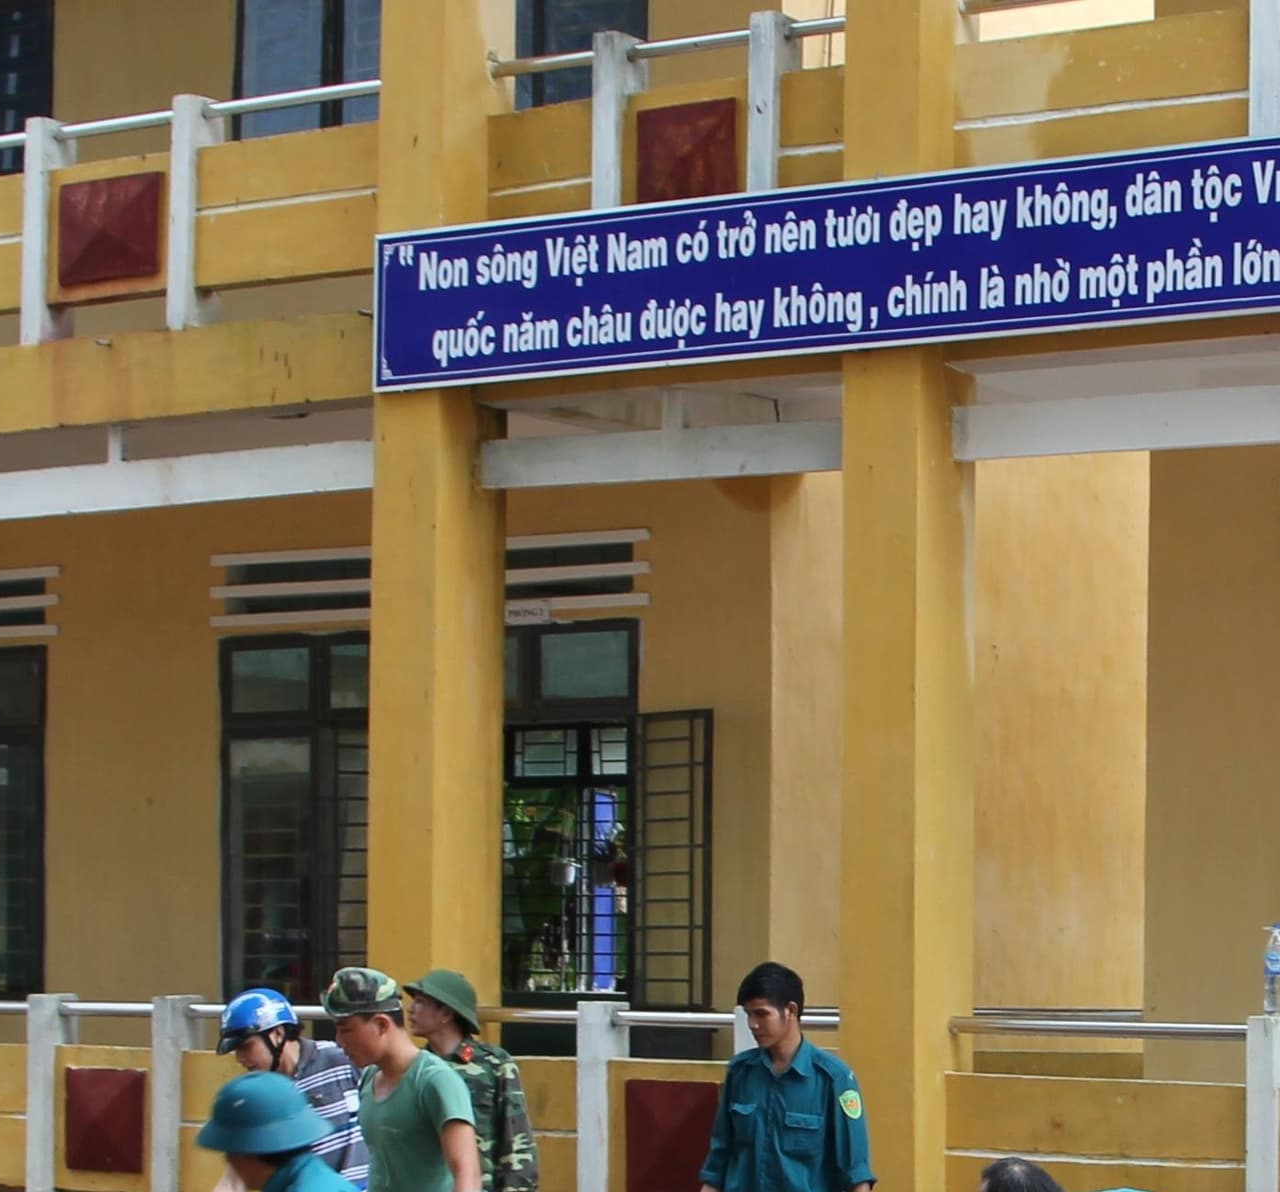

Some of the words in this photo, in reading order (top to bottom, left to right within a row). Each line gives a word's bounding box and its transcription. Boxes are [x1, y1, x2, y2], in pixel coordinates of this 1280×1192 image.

[477, 244, 538, 288] sông
[608, 232, 668, 272] Nam
[677, 220, 708, 263] có
[717, 210, 757, 258] trở
[765, 212, 816, 253] nên
[890, 199, 942, 251] đẹp
[954, 194, 1006, 240] hay
[1017, 183, 1117, 229] không,
[1126, 171, 1182, 216] dân
[1192, 166, 1242, 222] tộc
[433, 311, 495, 367] quốc
[504, 312, 558, 352] năm
[567, 304, 631, 346] châu
[640, 298, 706, 348] được
[716, 293, 765, 339] hay
[888, 271, 967, 317] chính
[981, 265, 1004, 309] là
[1016, 259, 1070, 305] nhờ
[1080, 254, 1138, 307] một
[1147, 239, 1222, 303] phần
[1234, 240, 1280, 284] lớn
